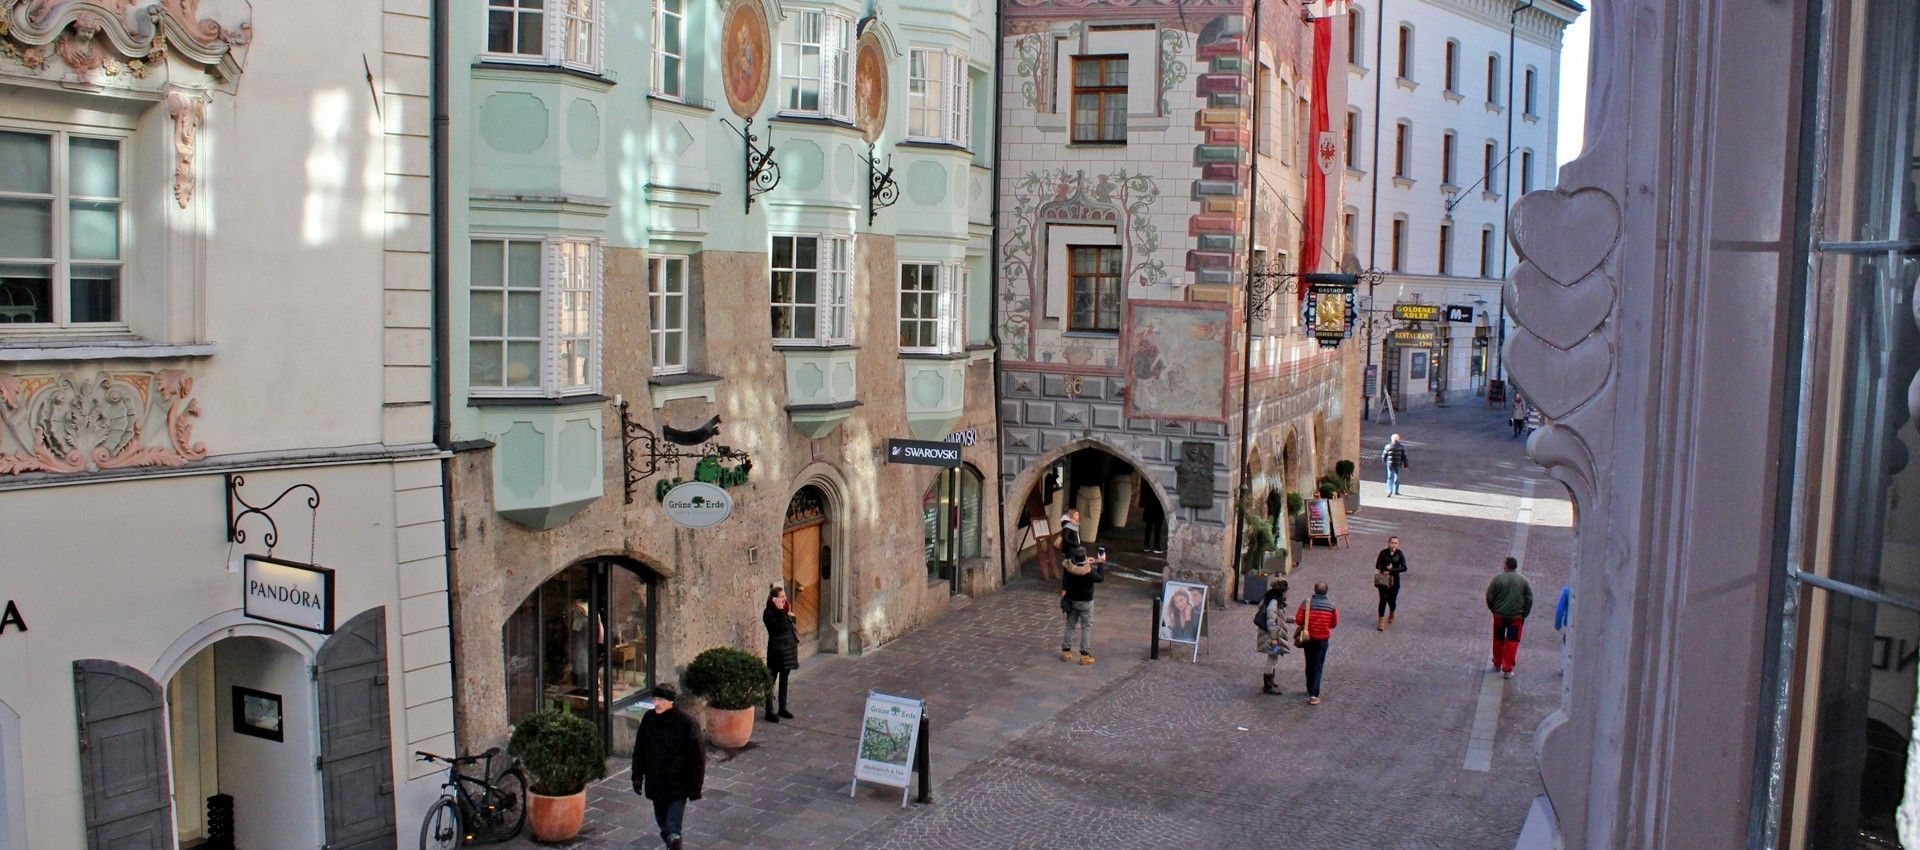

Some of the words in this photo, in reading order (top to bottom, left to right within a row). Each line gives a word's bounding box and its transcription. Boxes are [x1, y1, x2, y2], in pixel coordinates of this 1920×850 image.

[1396, 306, 1437, 314] GOLDENER
[904, 446, 958, 460] SWAROVSKI
[668, 500, 692, 509] Grüne
[705, 500, 725, 509] Erde
[250, 579, 321, 610] PANDORA
[0, 599, 28, 635] A
[901, 710, 917, 720] Erde
